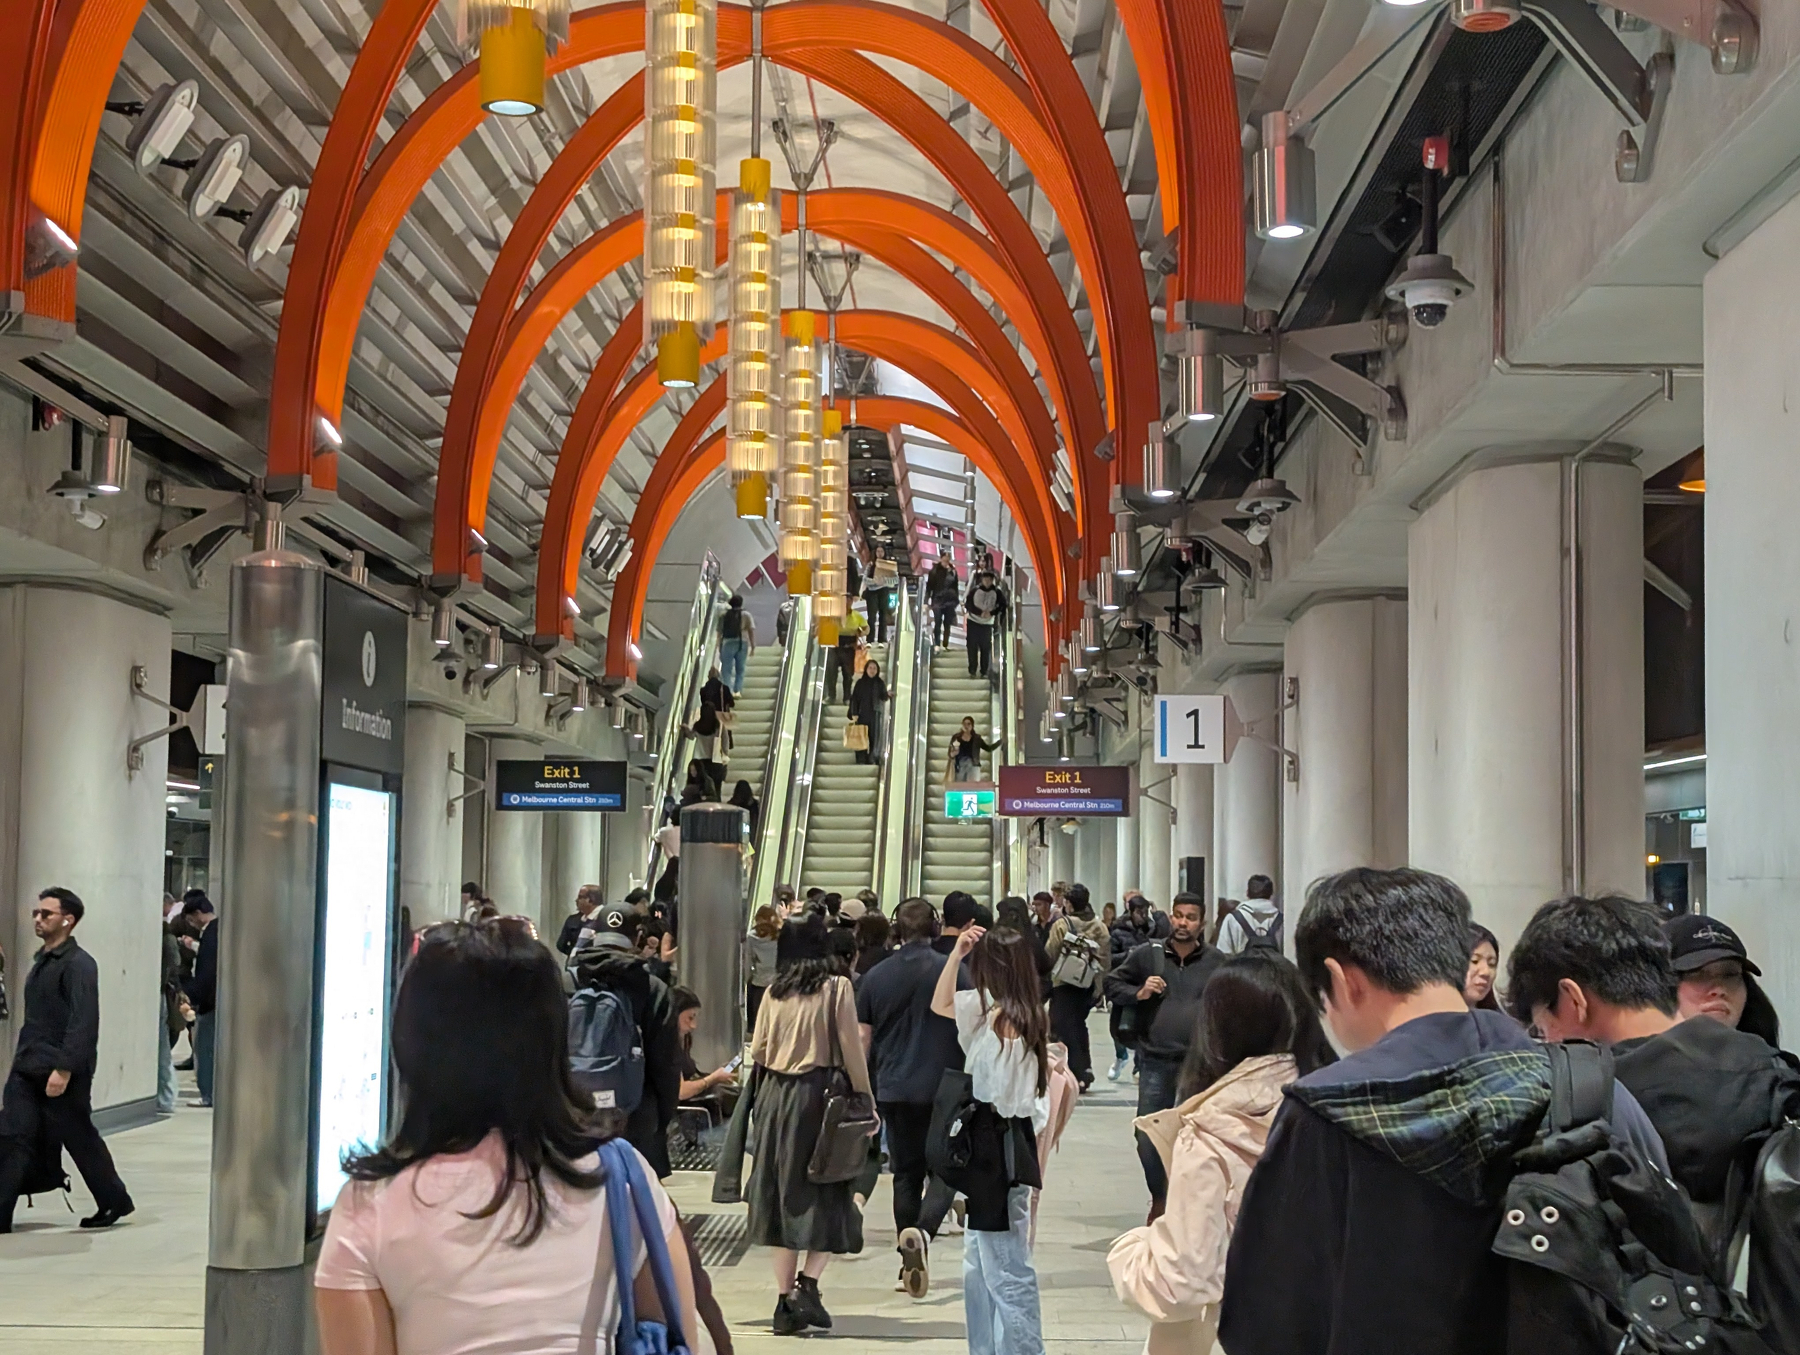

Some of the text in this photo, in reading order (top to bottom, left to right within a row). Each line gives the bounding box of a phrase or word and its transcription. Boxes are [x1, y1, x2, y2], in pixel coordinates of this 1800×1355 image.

[342, 698, 392, 740] Information
[1185, 708, 1206, 750] 1
[544, 766, 581, 778] Exit 1
[1045, 771, 1082, 783] Exit 1
[534, 781, 590, 789] Swanston Street
[1036, 786, 1091, 794] Swanston Street
[521, 795, 558, 804] Melbourne
[558, 795, 584, 804] Central
[584, 796, 597, 804] Stn
[1023, 801, 1059, 809] Melbourne
[1060, 801, 1085, 809] Central
[1086, 801, 1098, 809] Stn
